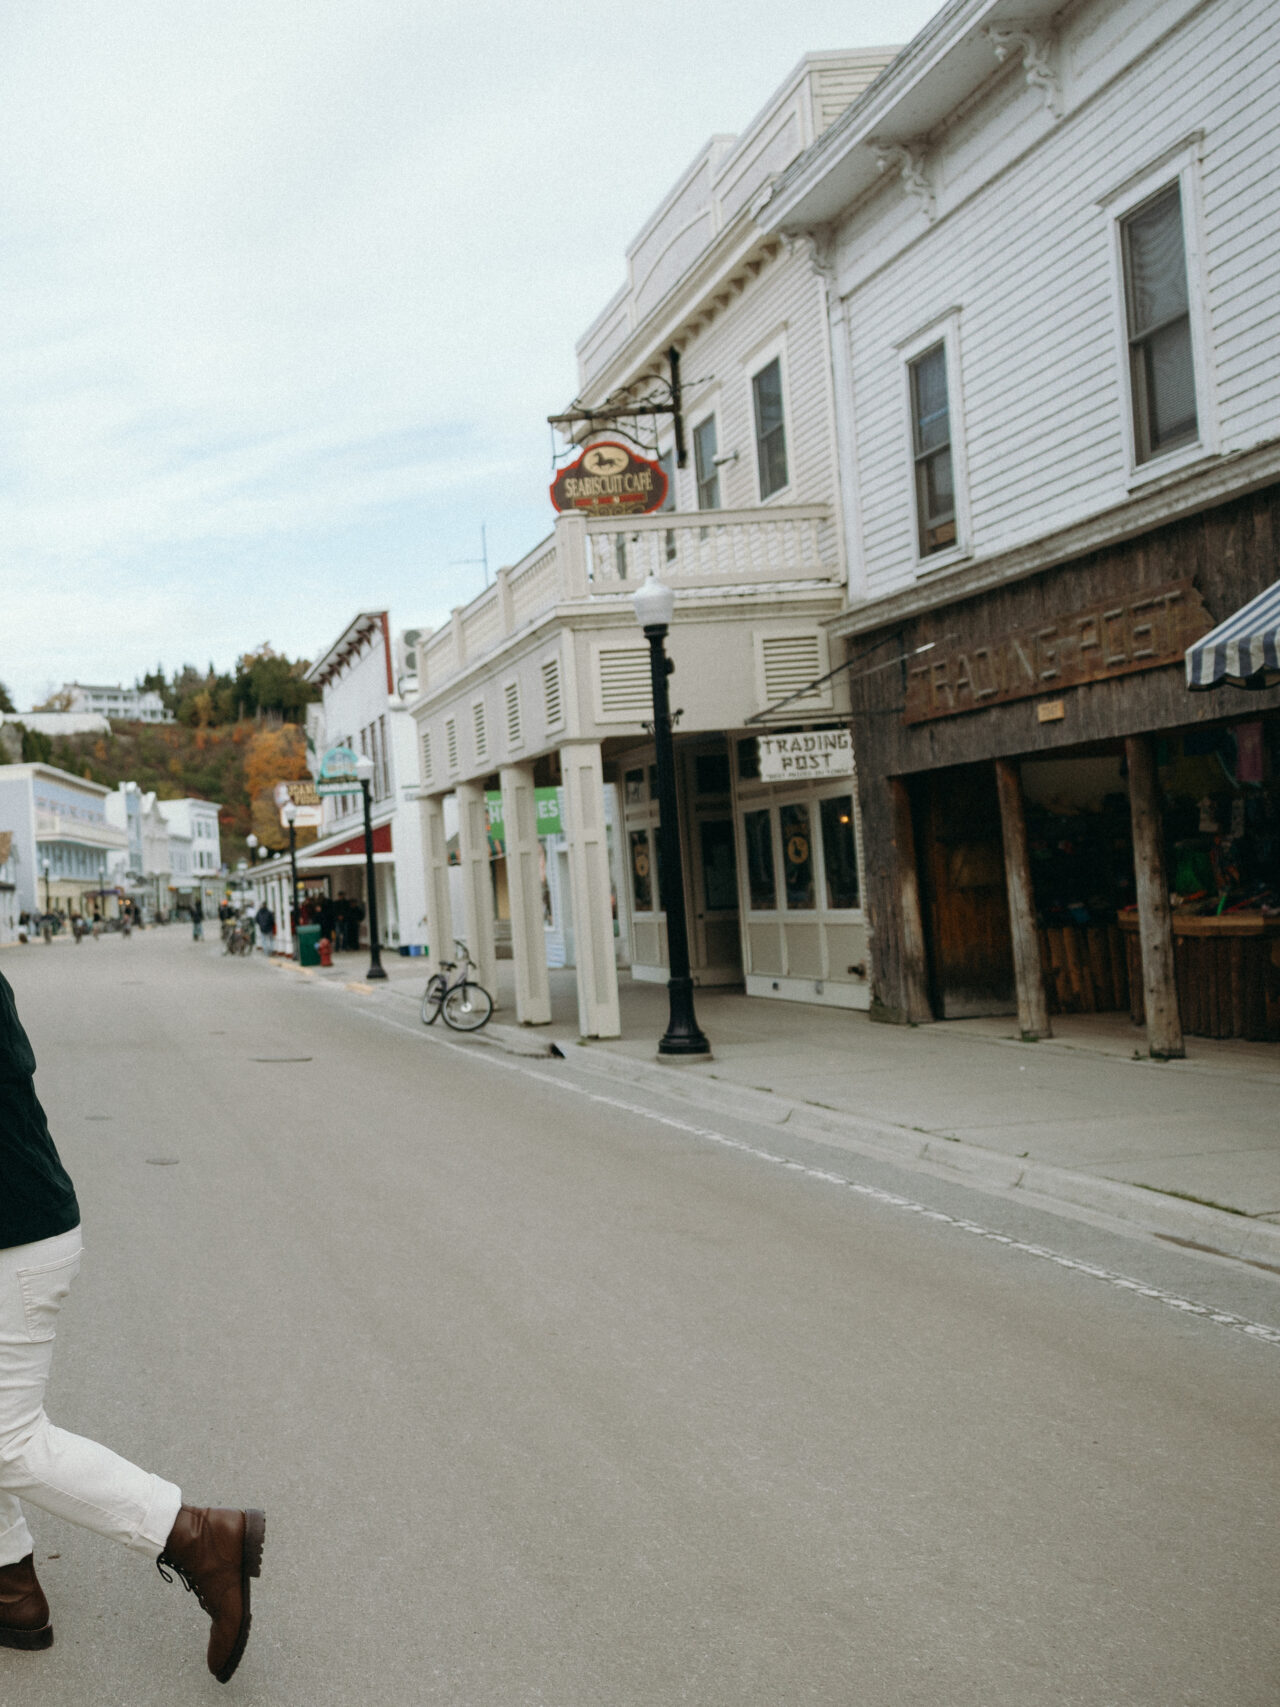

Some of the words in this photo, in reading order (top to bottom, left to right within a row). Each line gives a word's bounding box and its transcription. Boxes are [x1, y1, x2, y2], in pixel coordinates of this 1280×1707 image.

[565, 473, 623, 497] SEABISCUIT
[624, 467, 653, 493] CAFÉ
[1075, 590, 1182, 674] POST
[763, 733, 849, 755] TRADING
[782, 752, 833, 771] POST
